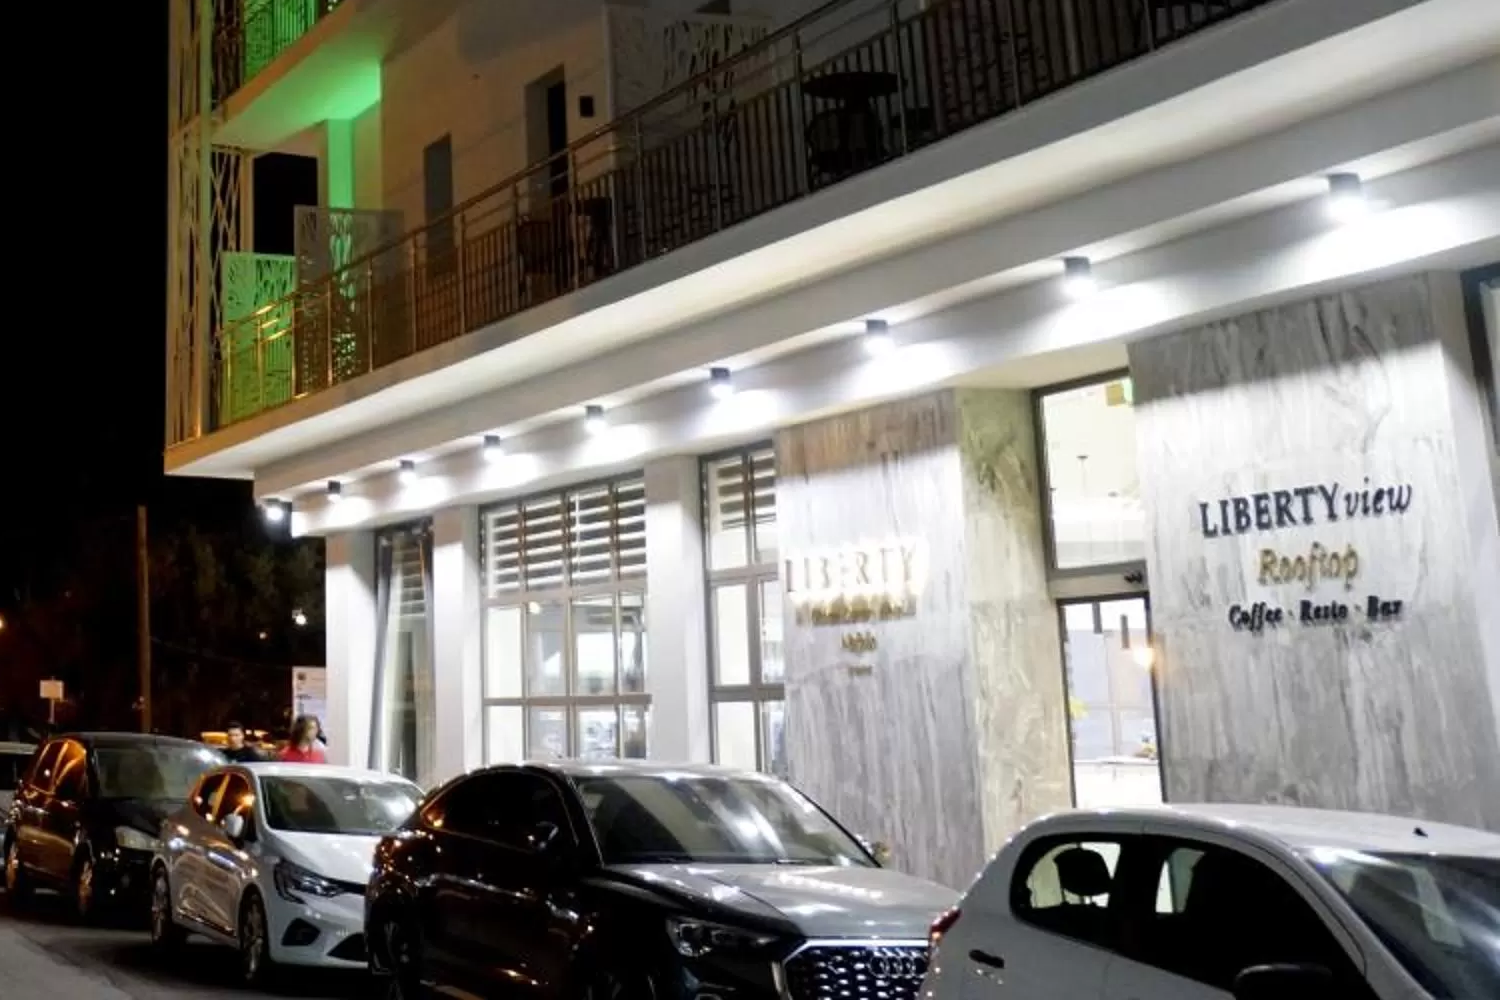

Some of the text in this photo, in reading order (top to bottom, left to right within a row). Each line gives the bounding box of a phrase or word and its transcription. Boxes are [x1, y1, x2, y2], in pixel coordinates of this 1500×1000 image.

[1257, 541, 1359, 593] Rooftop
[1229, 595, 1404, 633] Coffee Resto Bar
